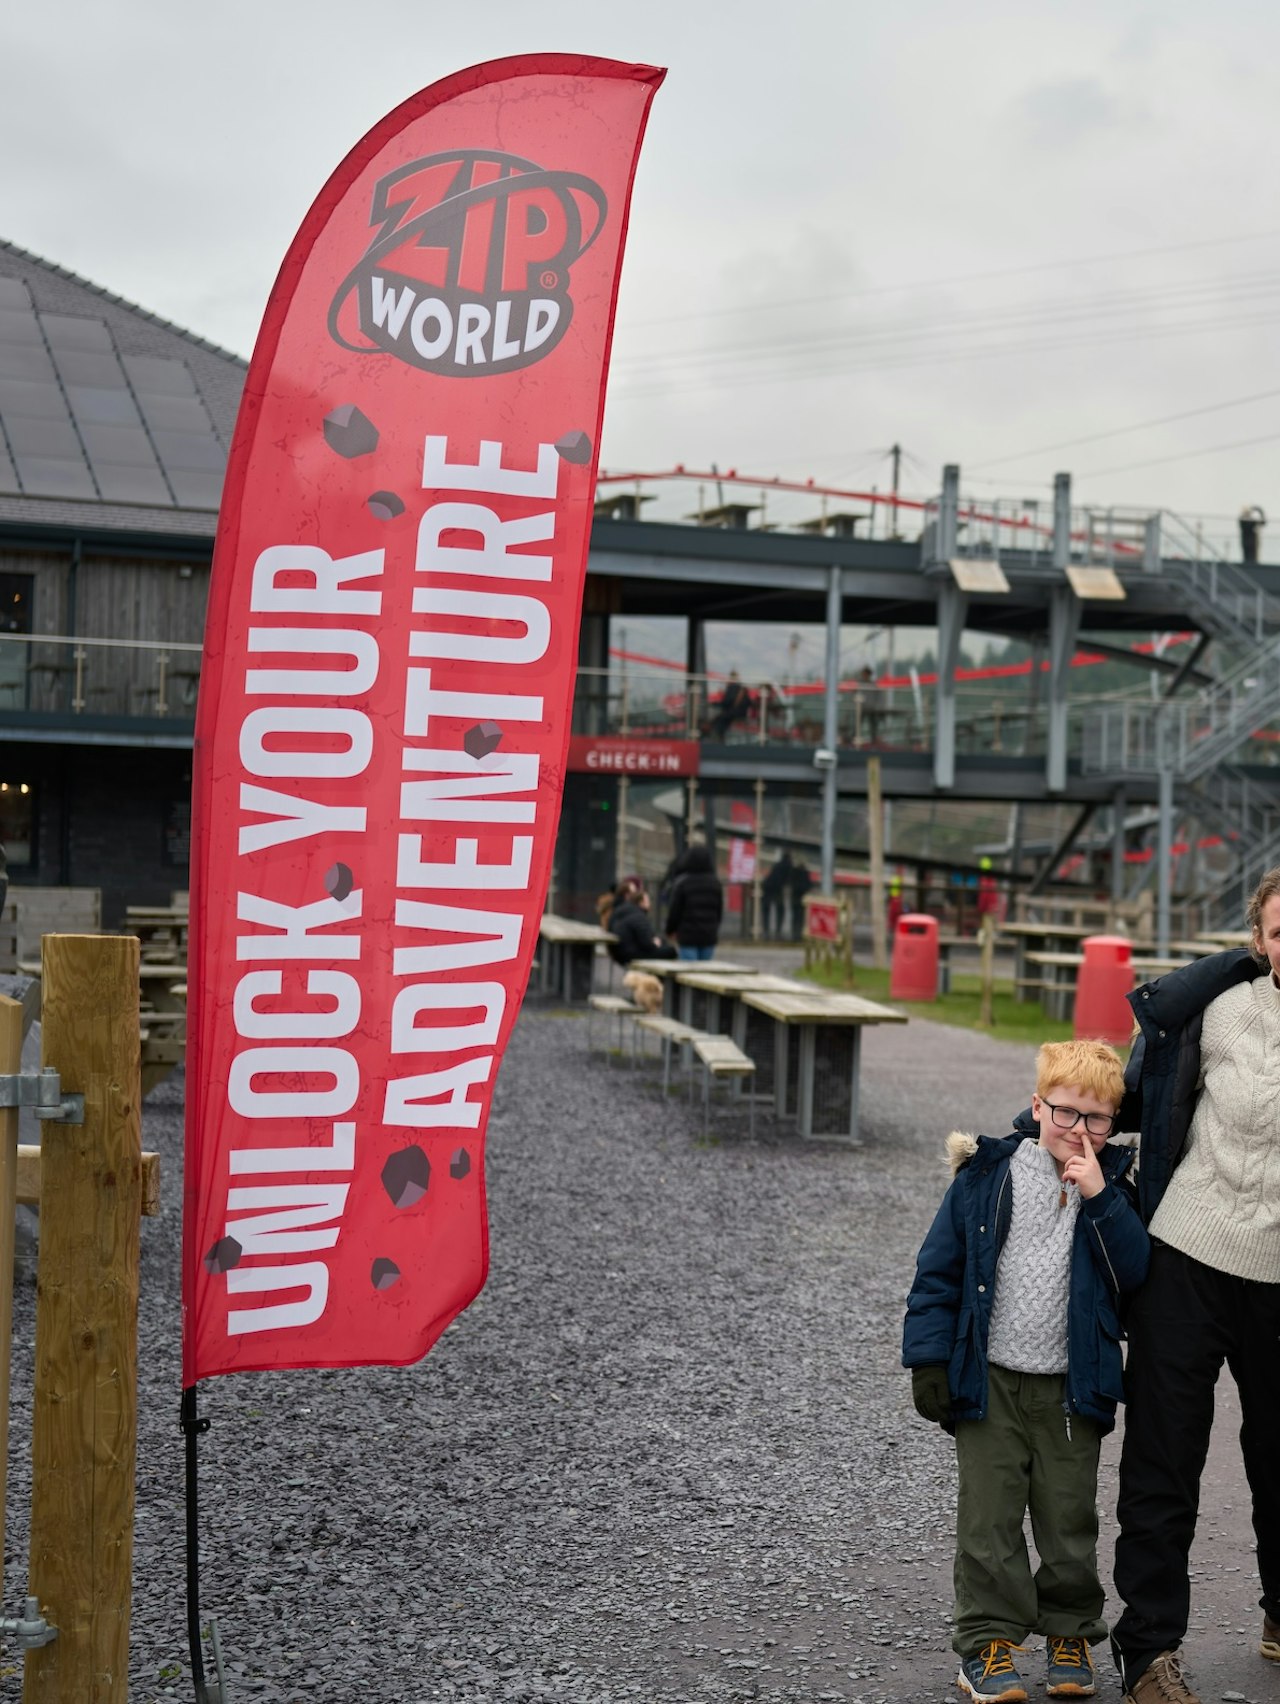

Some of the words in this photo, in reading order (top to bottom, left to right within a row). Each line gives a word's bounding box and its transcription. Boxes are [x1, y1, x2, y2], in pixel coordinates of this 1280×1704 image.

[371, 276, 561, 366] WORLD
[374, 159, 568, 294] ZIP
[238, 544, 386, 856] YOUR
[382, 435, 560, 1129] ADVENTURE
[586, 750, 680, 770] CHECK-IN
[225, 888, 363, 1335] UNLOCK
